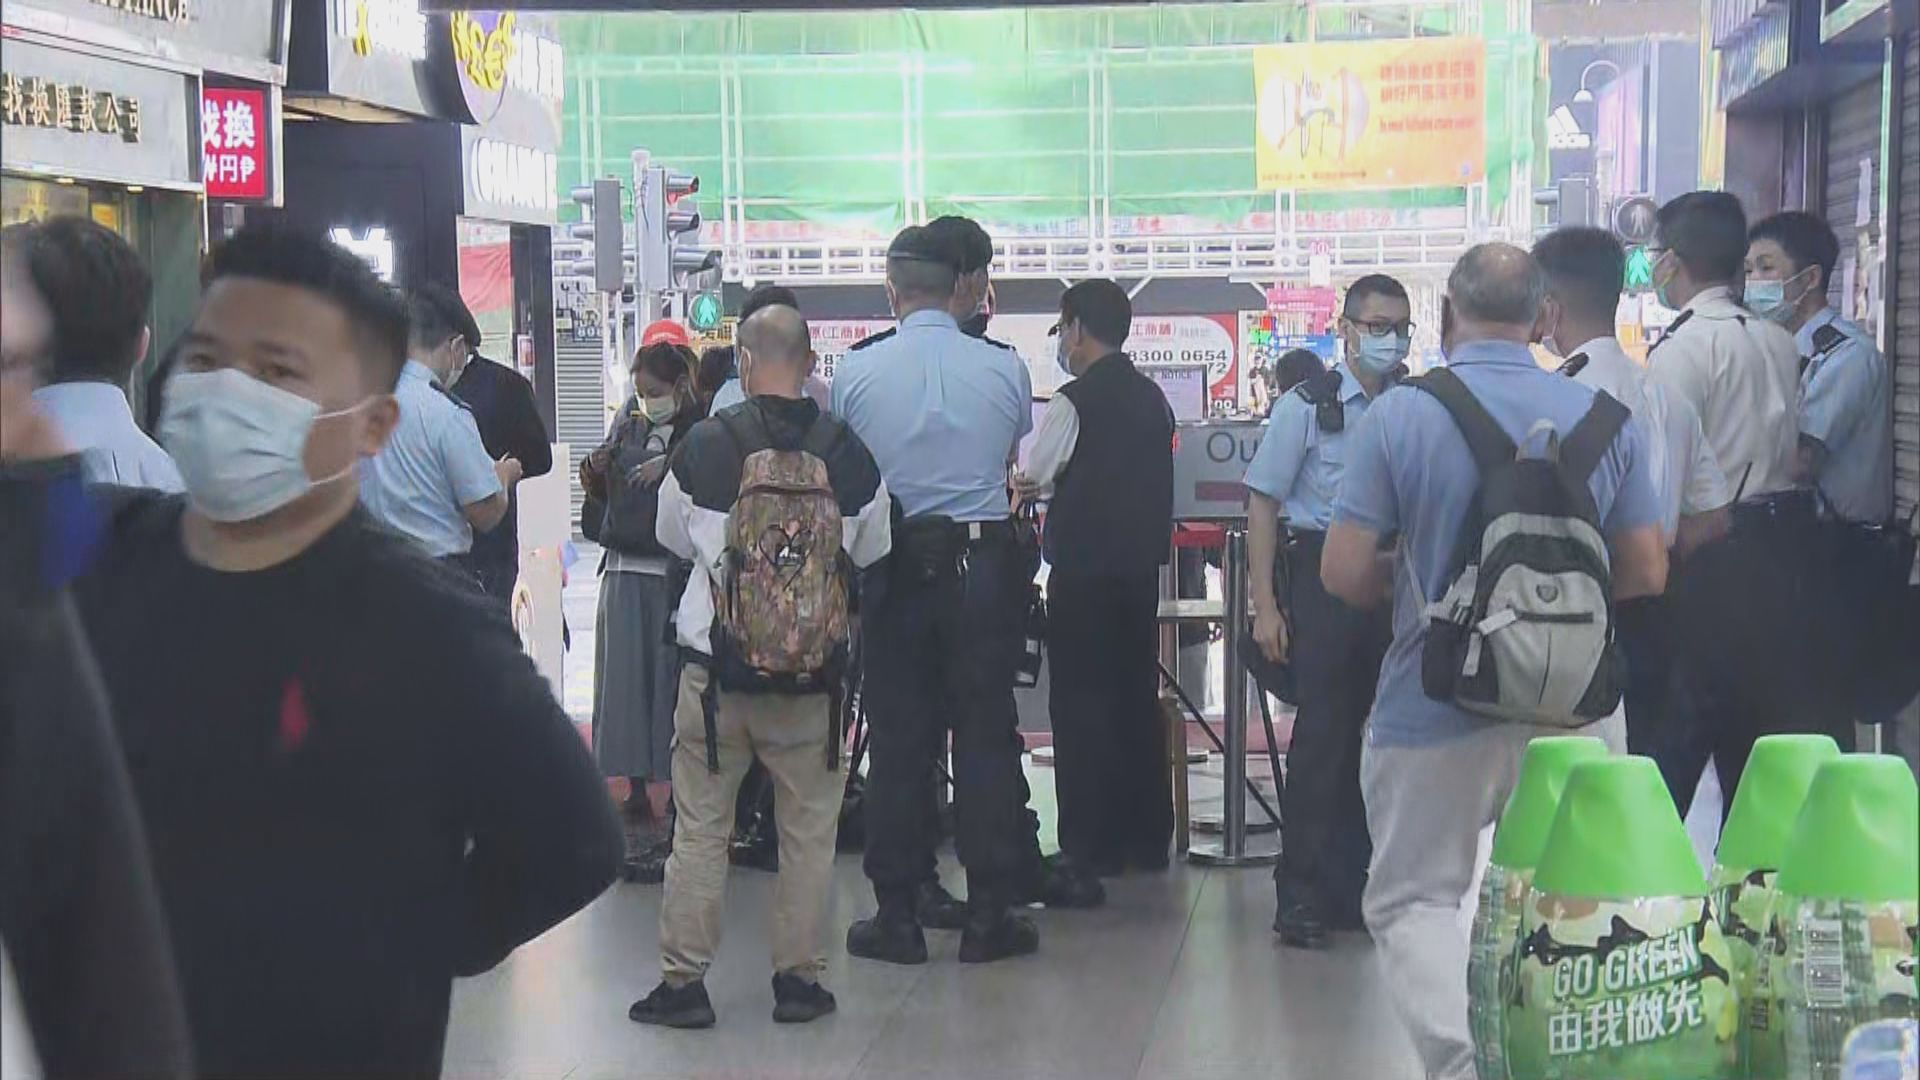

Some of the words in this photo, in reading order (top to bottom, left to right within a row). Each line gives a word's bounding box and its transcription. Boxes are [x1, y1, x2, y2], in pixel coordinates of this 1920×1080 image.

[1181, 350, 1227, 361] 0654
[1553, 953, 1594, 998] GO
[1604, 924, 1700, 991] GREEN
[1549, 978, 1702, 1055] 由我做先
